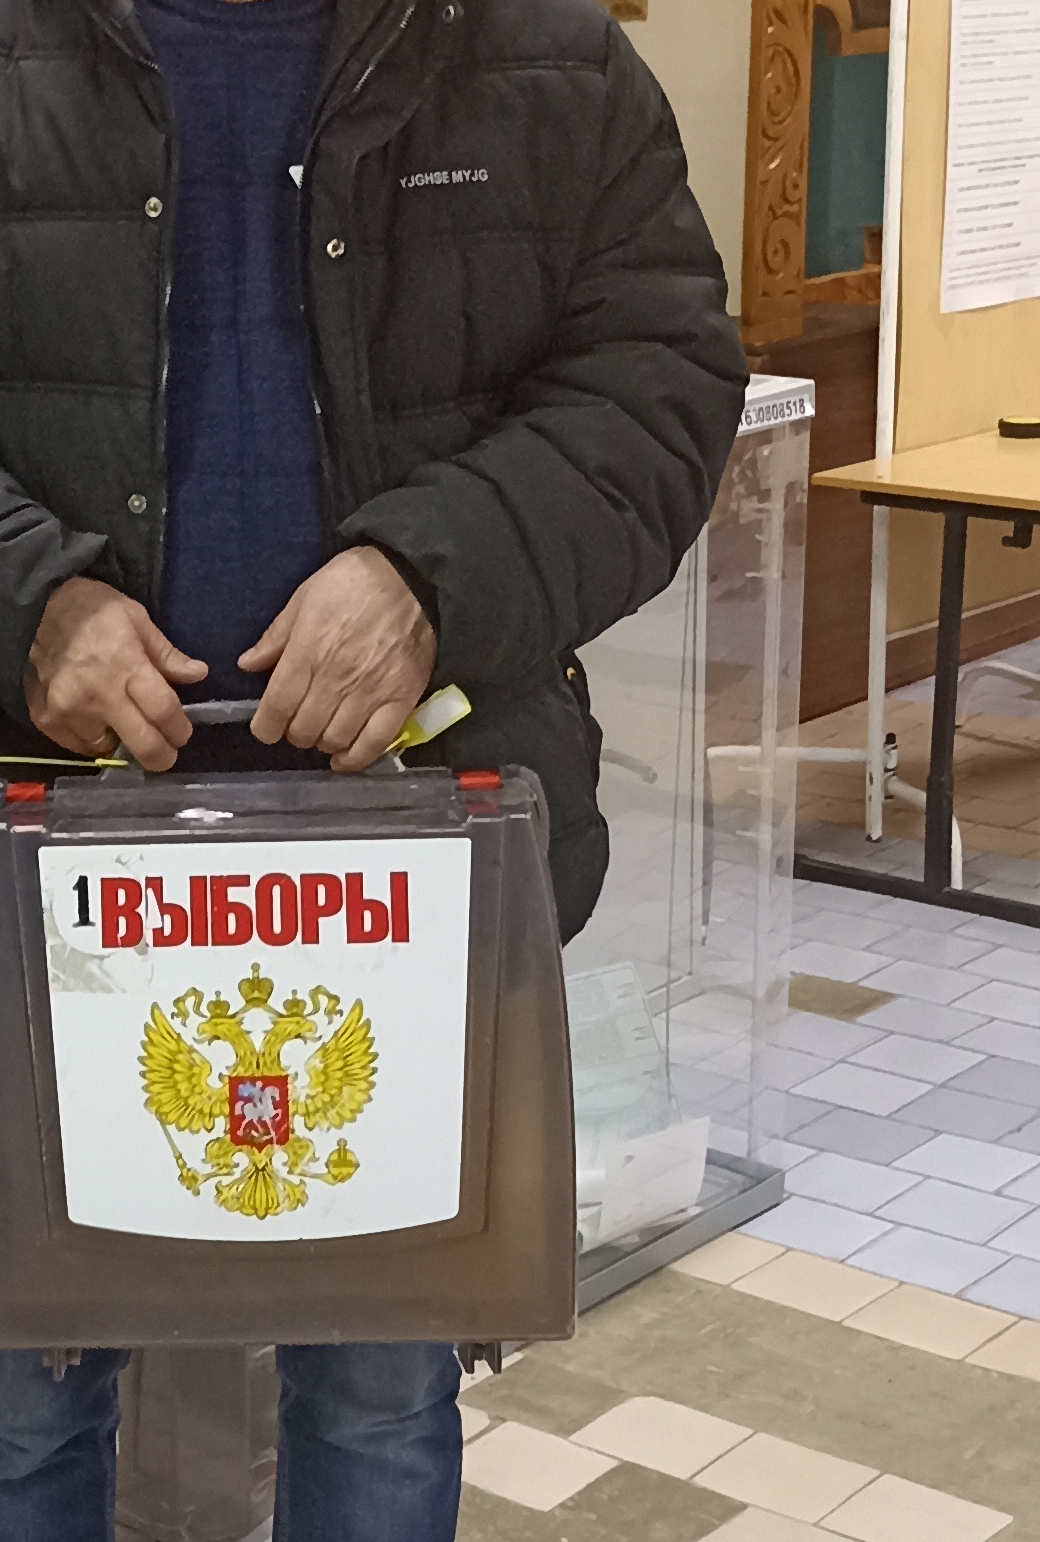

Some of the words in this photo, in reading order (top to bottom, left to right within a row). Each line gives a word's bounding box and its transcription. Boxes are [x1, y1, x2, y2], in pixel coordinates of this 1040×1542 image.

[452, 168, 488, 183] MYJG
[72, 875, 96, 928] 1
[100, 871, 410, 949] ВЫБОРЫ
